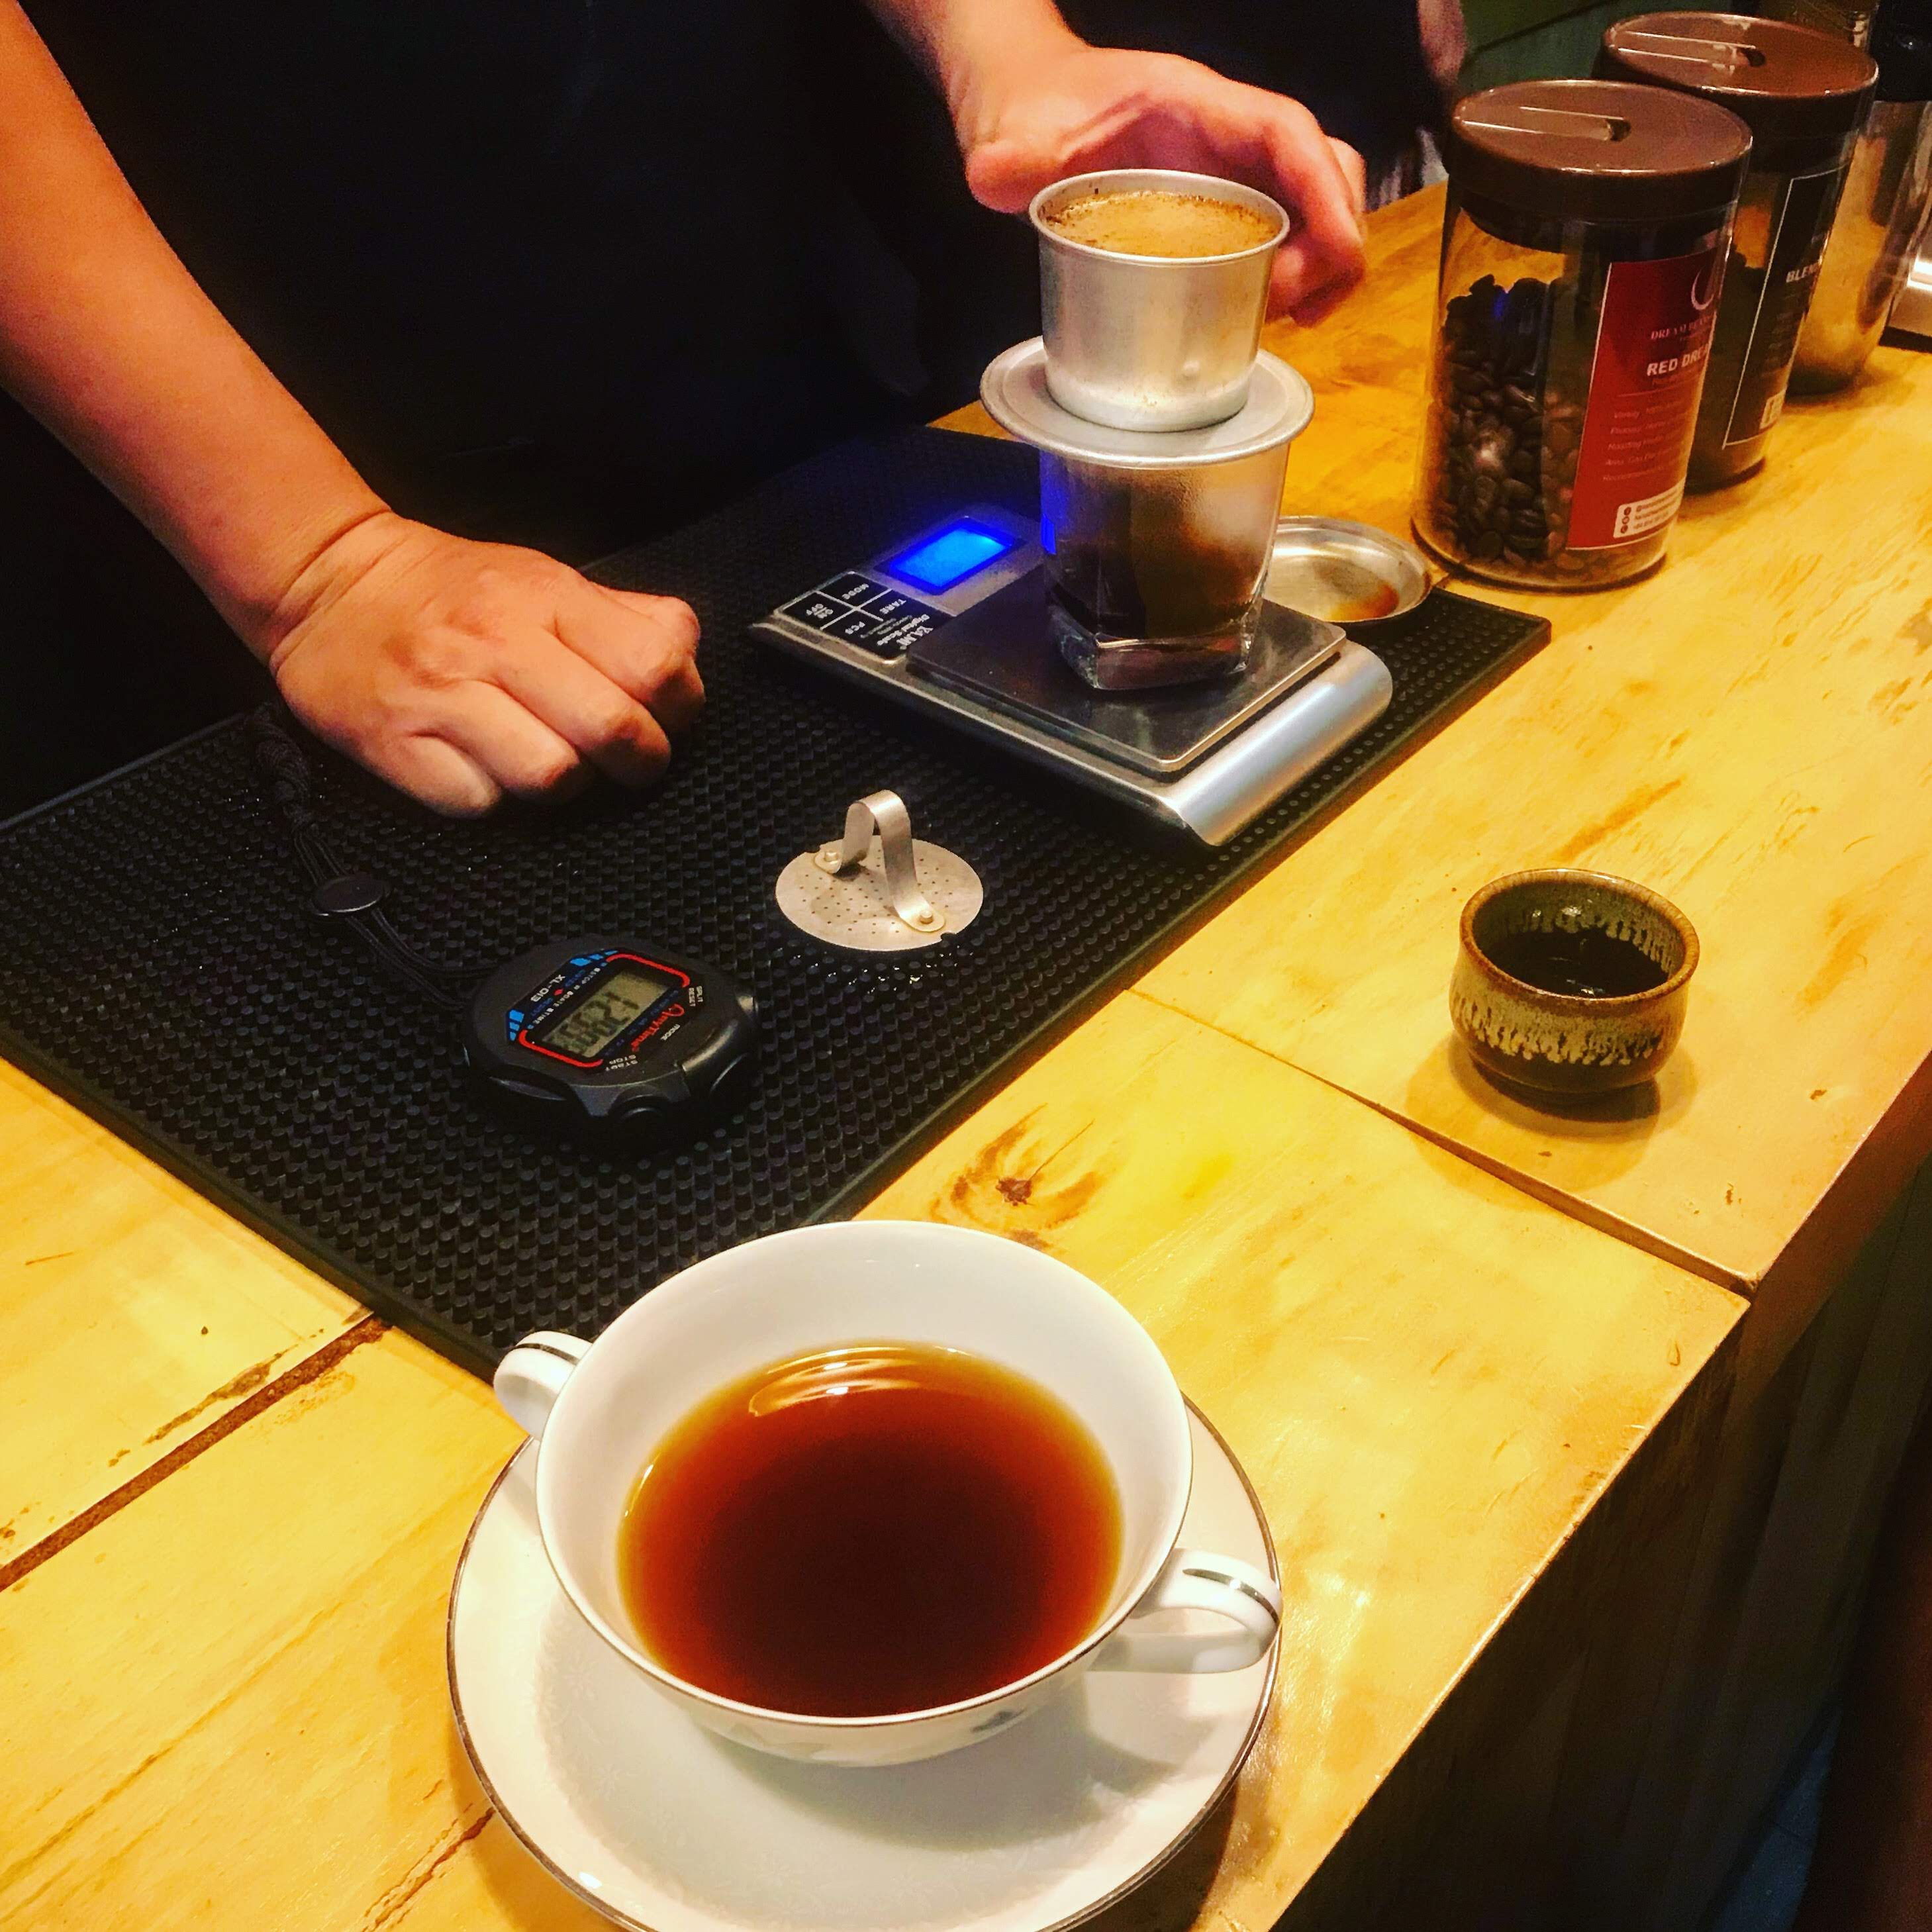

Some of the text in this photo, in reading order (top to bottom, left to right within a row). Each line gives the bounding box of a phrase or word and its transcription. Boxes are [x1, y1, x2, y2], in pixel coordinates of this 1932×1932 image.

[1647, 358, 1678, 377] RED
[842, 583, 869, 600] MODE
[806, 603, 824, 616] OFF
[817, 608, 834, 619] ON
[879, 599, 907, 614] TARE
[900, 614, 930, 633] Digital
[877, 629, 902, 646] Scale
[530, 974, 565, 1002] XL-013
